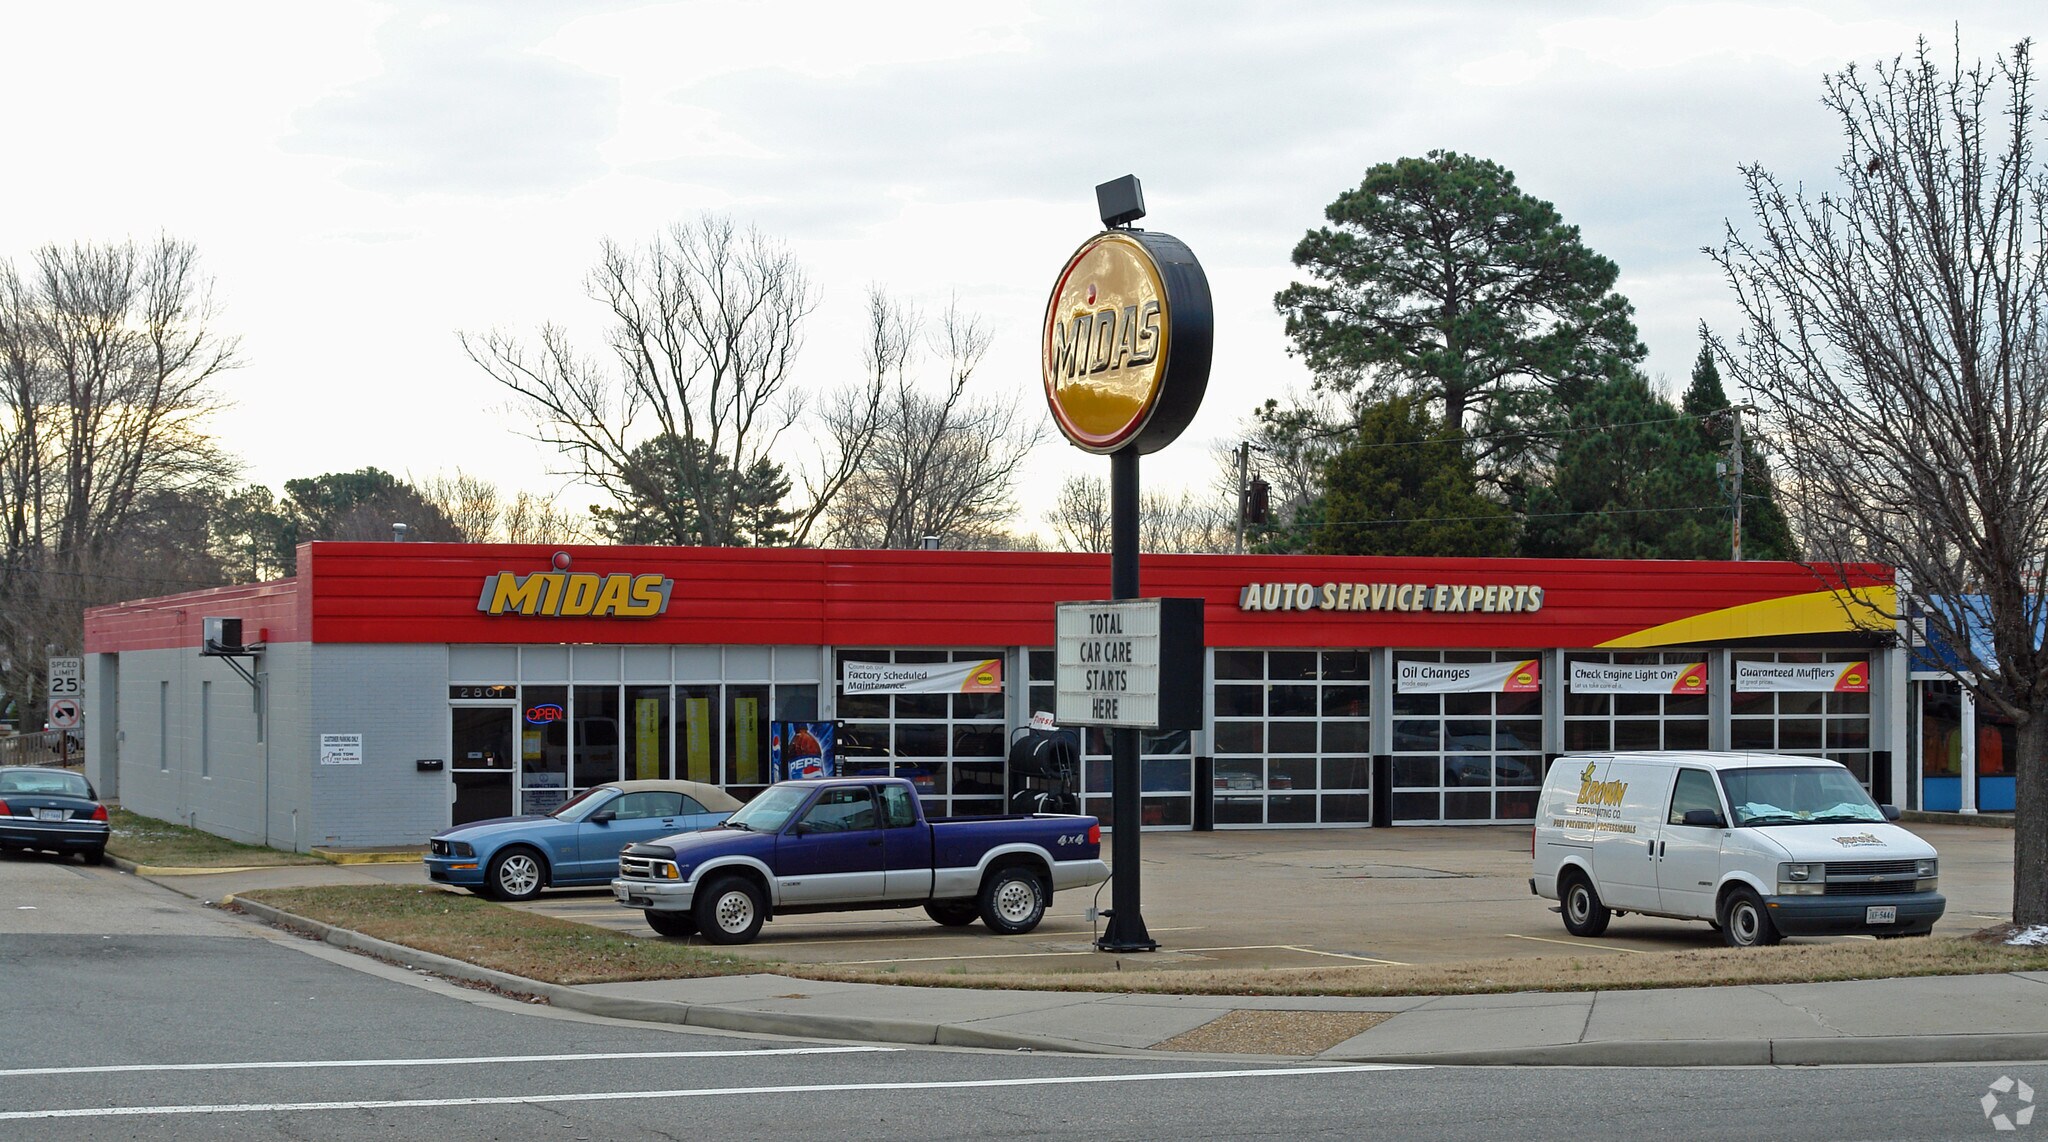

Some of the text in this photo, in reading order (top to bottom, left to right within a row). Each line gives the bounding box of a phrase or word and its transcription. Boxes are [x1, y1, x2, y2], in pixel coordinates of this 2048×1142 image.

[1053, 300, 1161, 391] MIDAS
[488, 571, 664, 617] MIDAS
[1241, 583, 1543, 613] AUTO SERVICE EXPERTS
[1089, 613, 1123, 635] TOTAL
[1080, 641, 1132, 663] CAR CARE
[848, 671, 928, 681] Factory Scheduled
[1085, 670, 1127, 691] STARTS
[1402, 666, 1470, 681] Oil Changes
[1575, 669, 1678, 681] Check Engine Light On?
[1740, 668, 1835, 680] Guaranteed Mufflers
[52, 678, 78, 692] 25
[848, 681, 906, 690] Maintenance.
[460, 688, 502, 698] 2801
[526, 707, 562, 720] OPEN
[1092, 698, 1119, 720] HERE
[1552, 819, 1636, 834] PEST PREVENTION PROFESSIONALS
